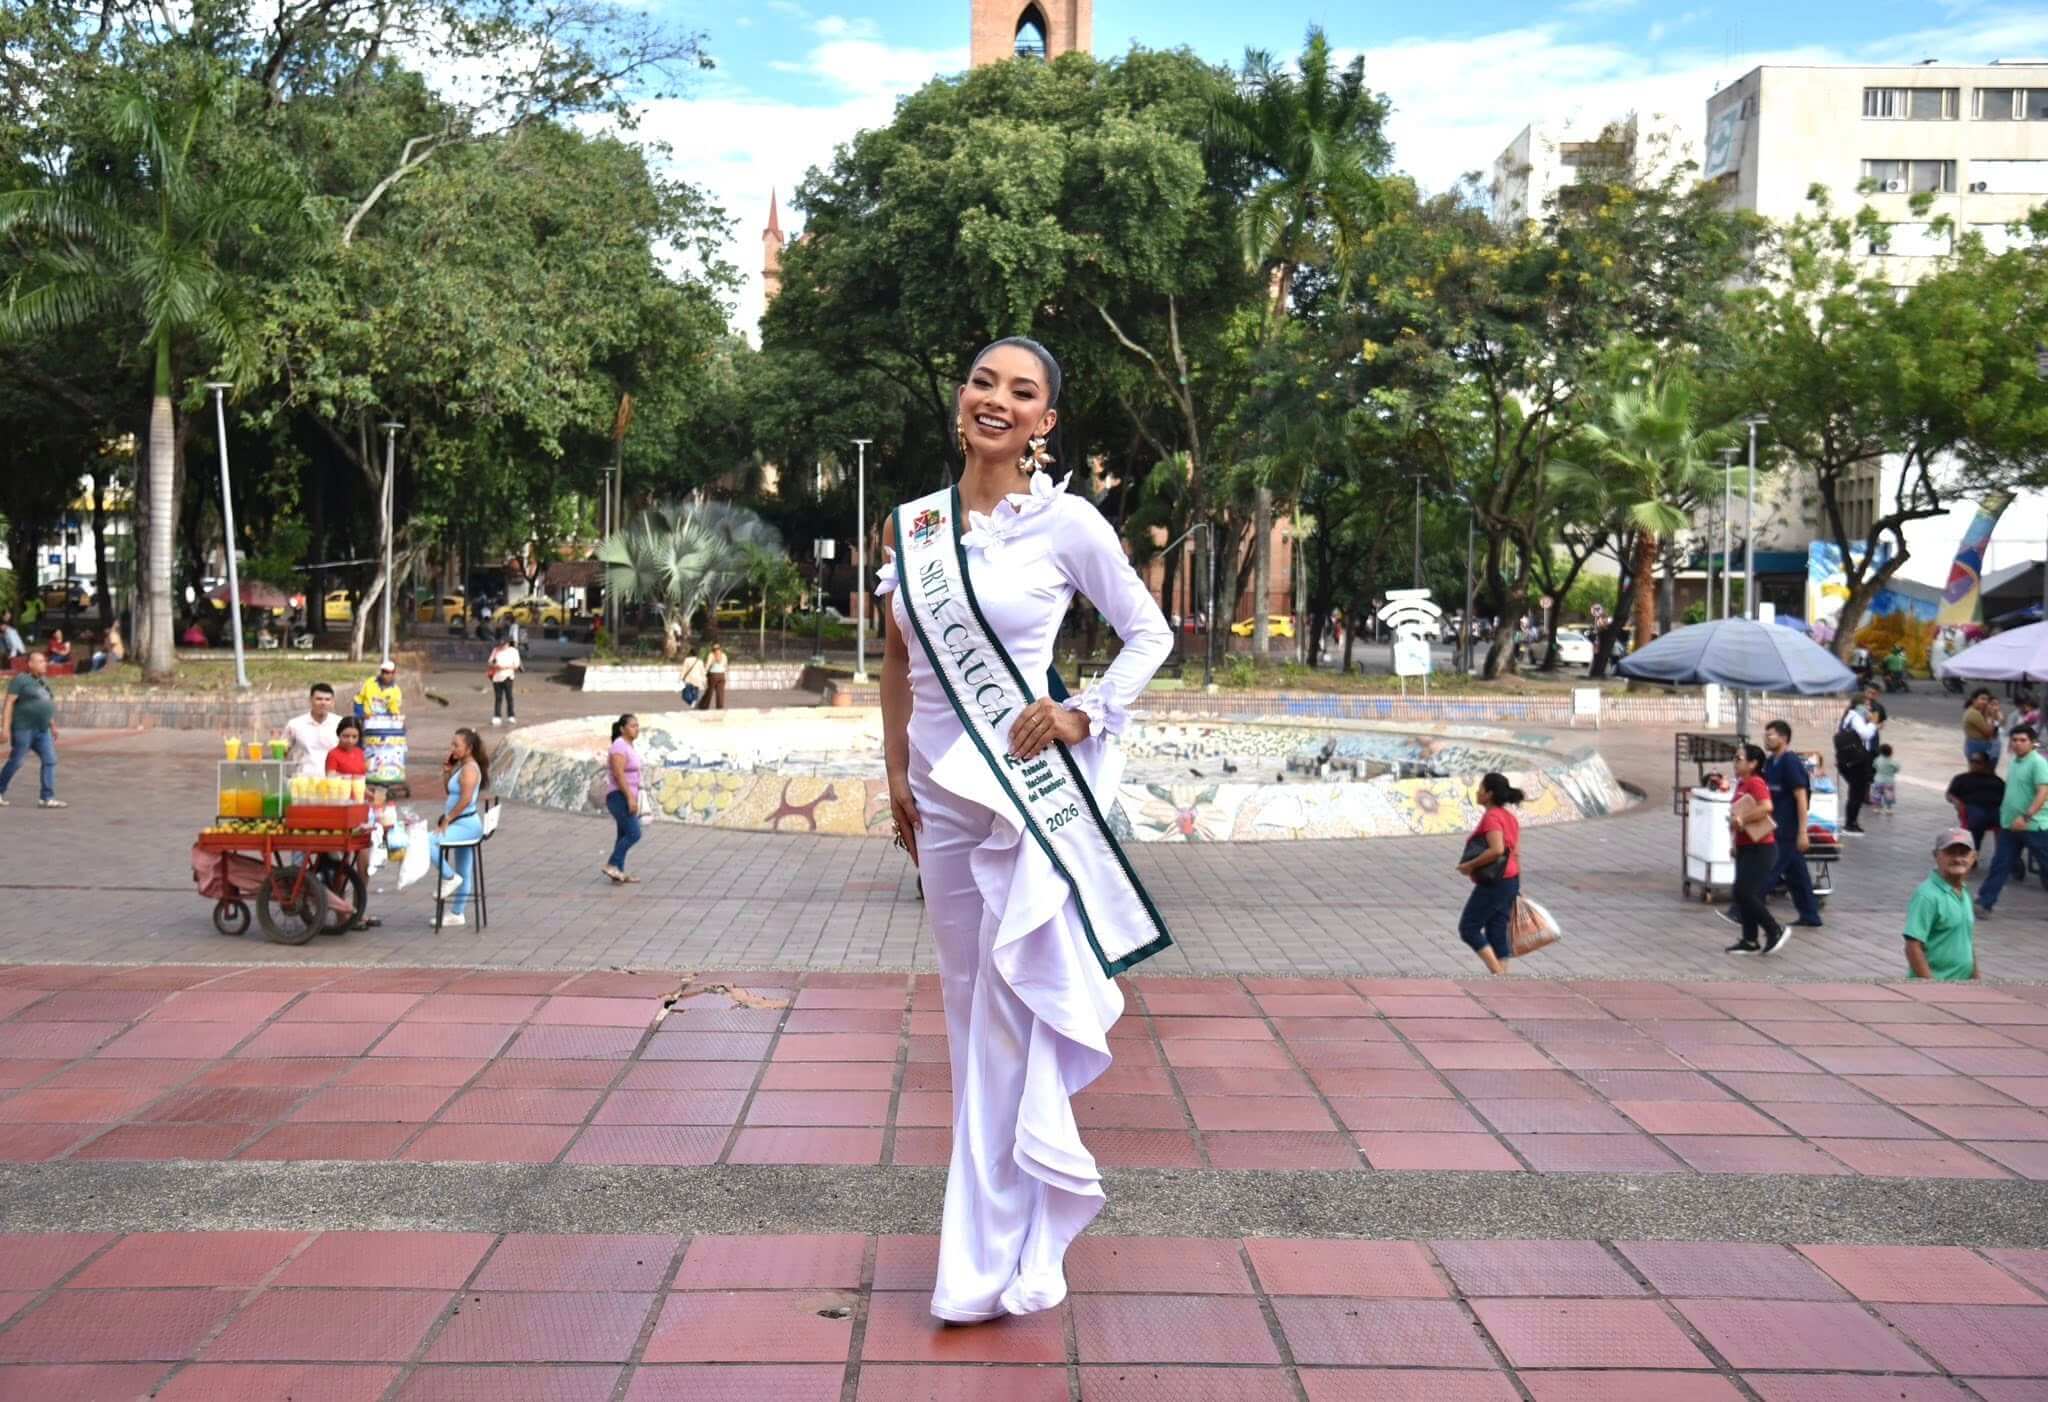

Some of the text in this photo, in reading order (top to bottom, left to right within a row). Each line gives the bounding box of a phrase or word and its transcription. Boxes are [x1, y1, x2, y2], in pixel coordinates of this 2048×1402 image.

[919, 559, 1013, 729] SRTA. CAUCA
[1046, 803, 1079, 832] 2026
